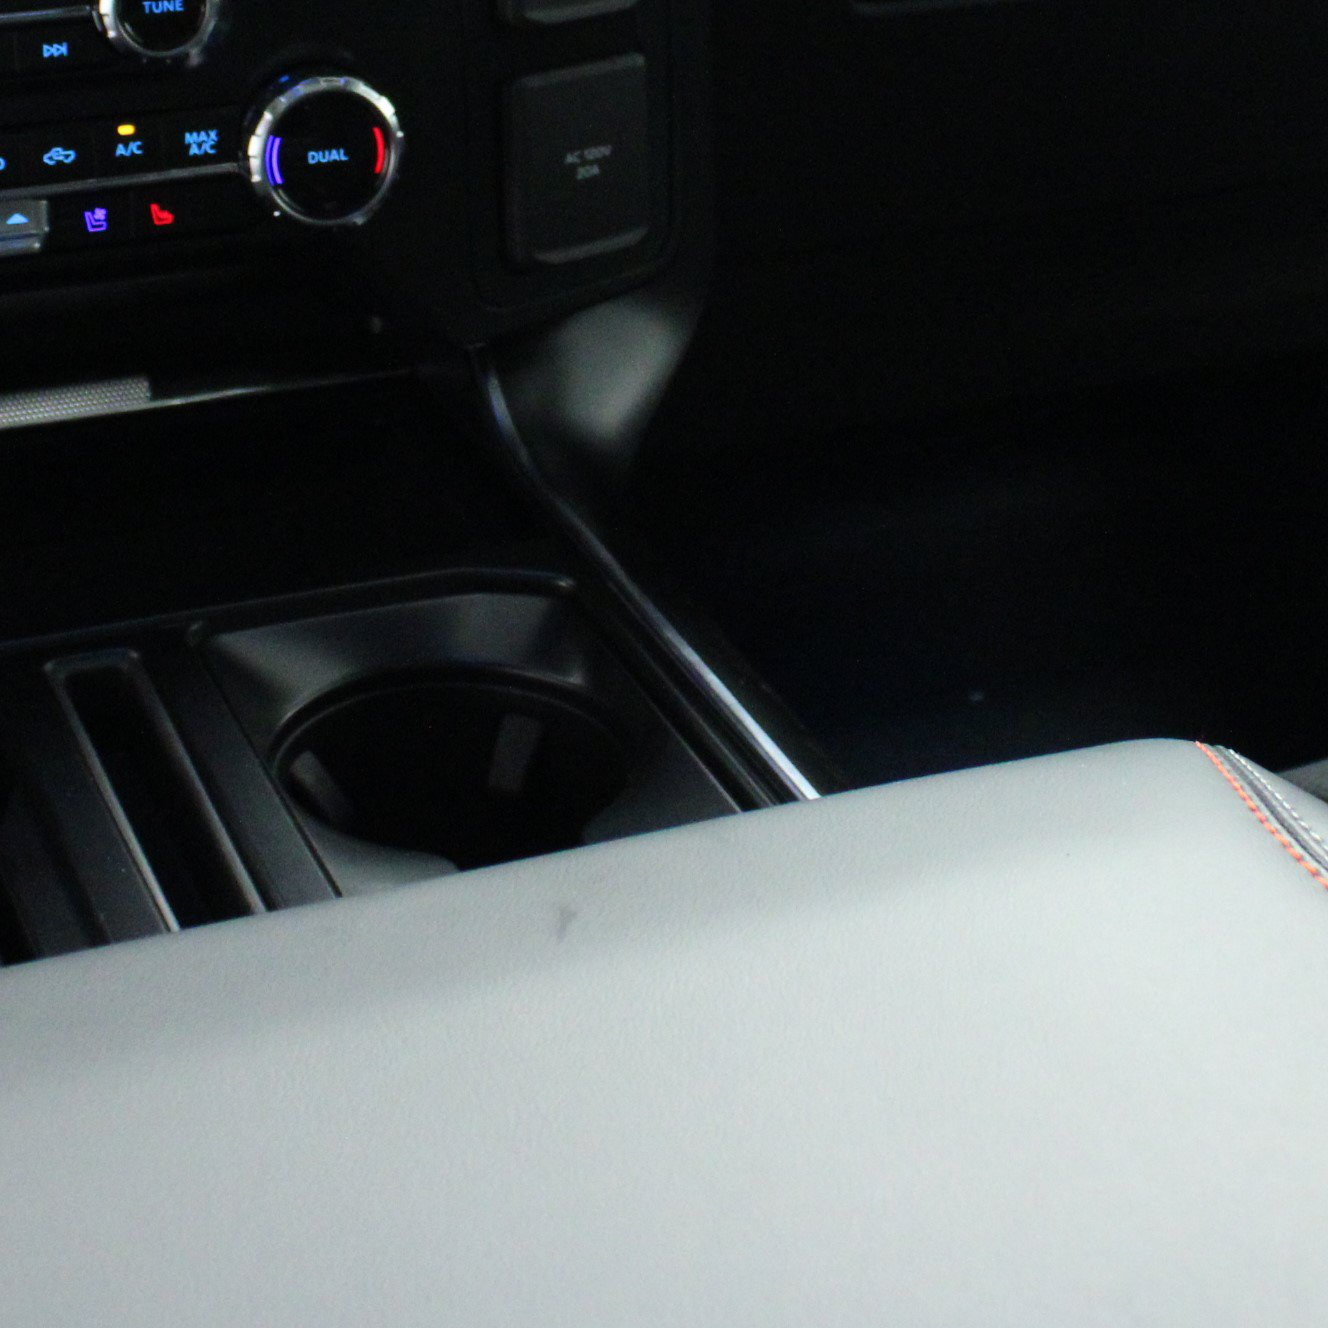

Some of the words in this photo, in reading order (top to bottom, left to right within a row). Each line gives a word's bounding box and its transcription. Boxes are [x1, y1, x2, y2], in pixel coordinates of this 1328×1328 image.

[184, 129, 220, 145] MAX
[115, 140, 144, 158] A/C
[188, 140, 218, 157] A/C
[306, 148, 350, 165] DUAL
